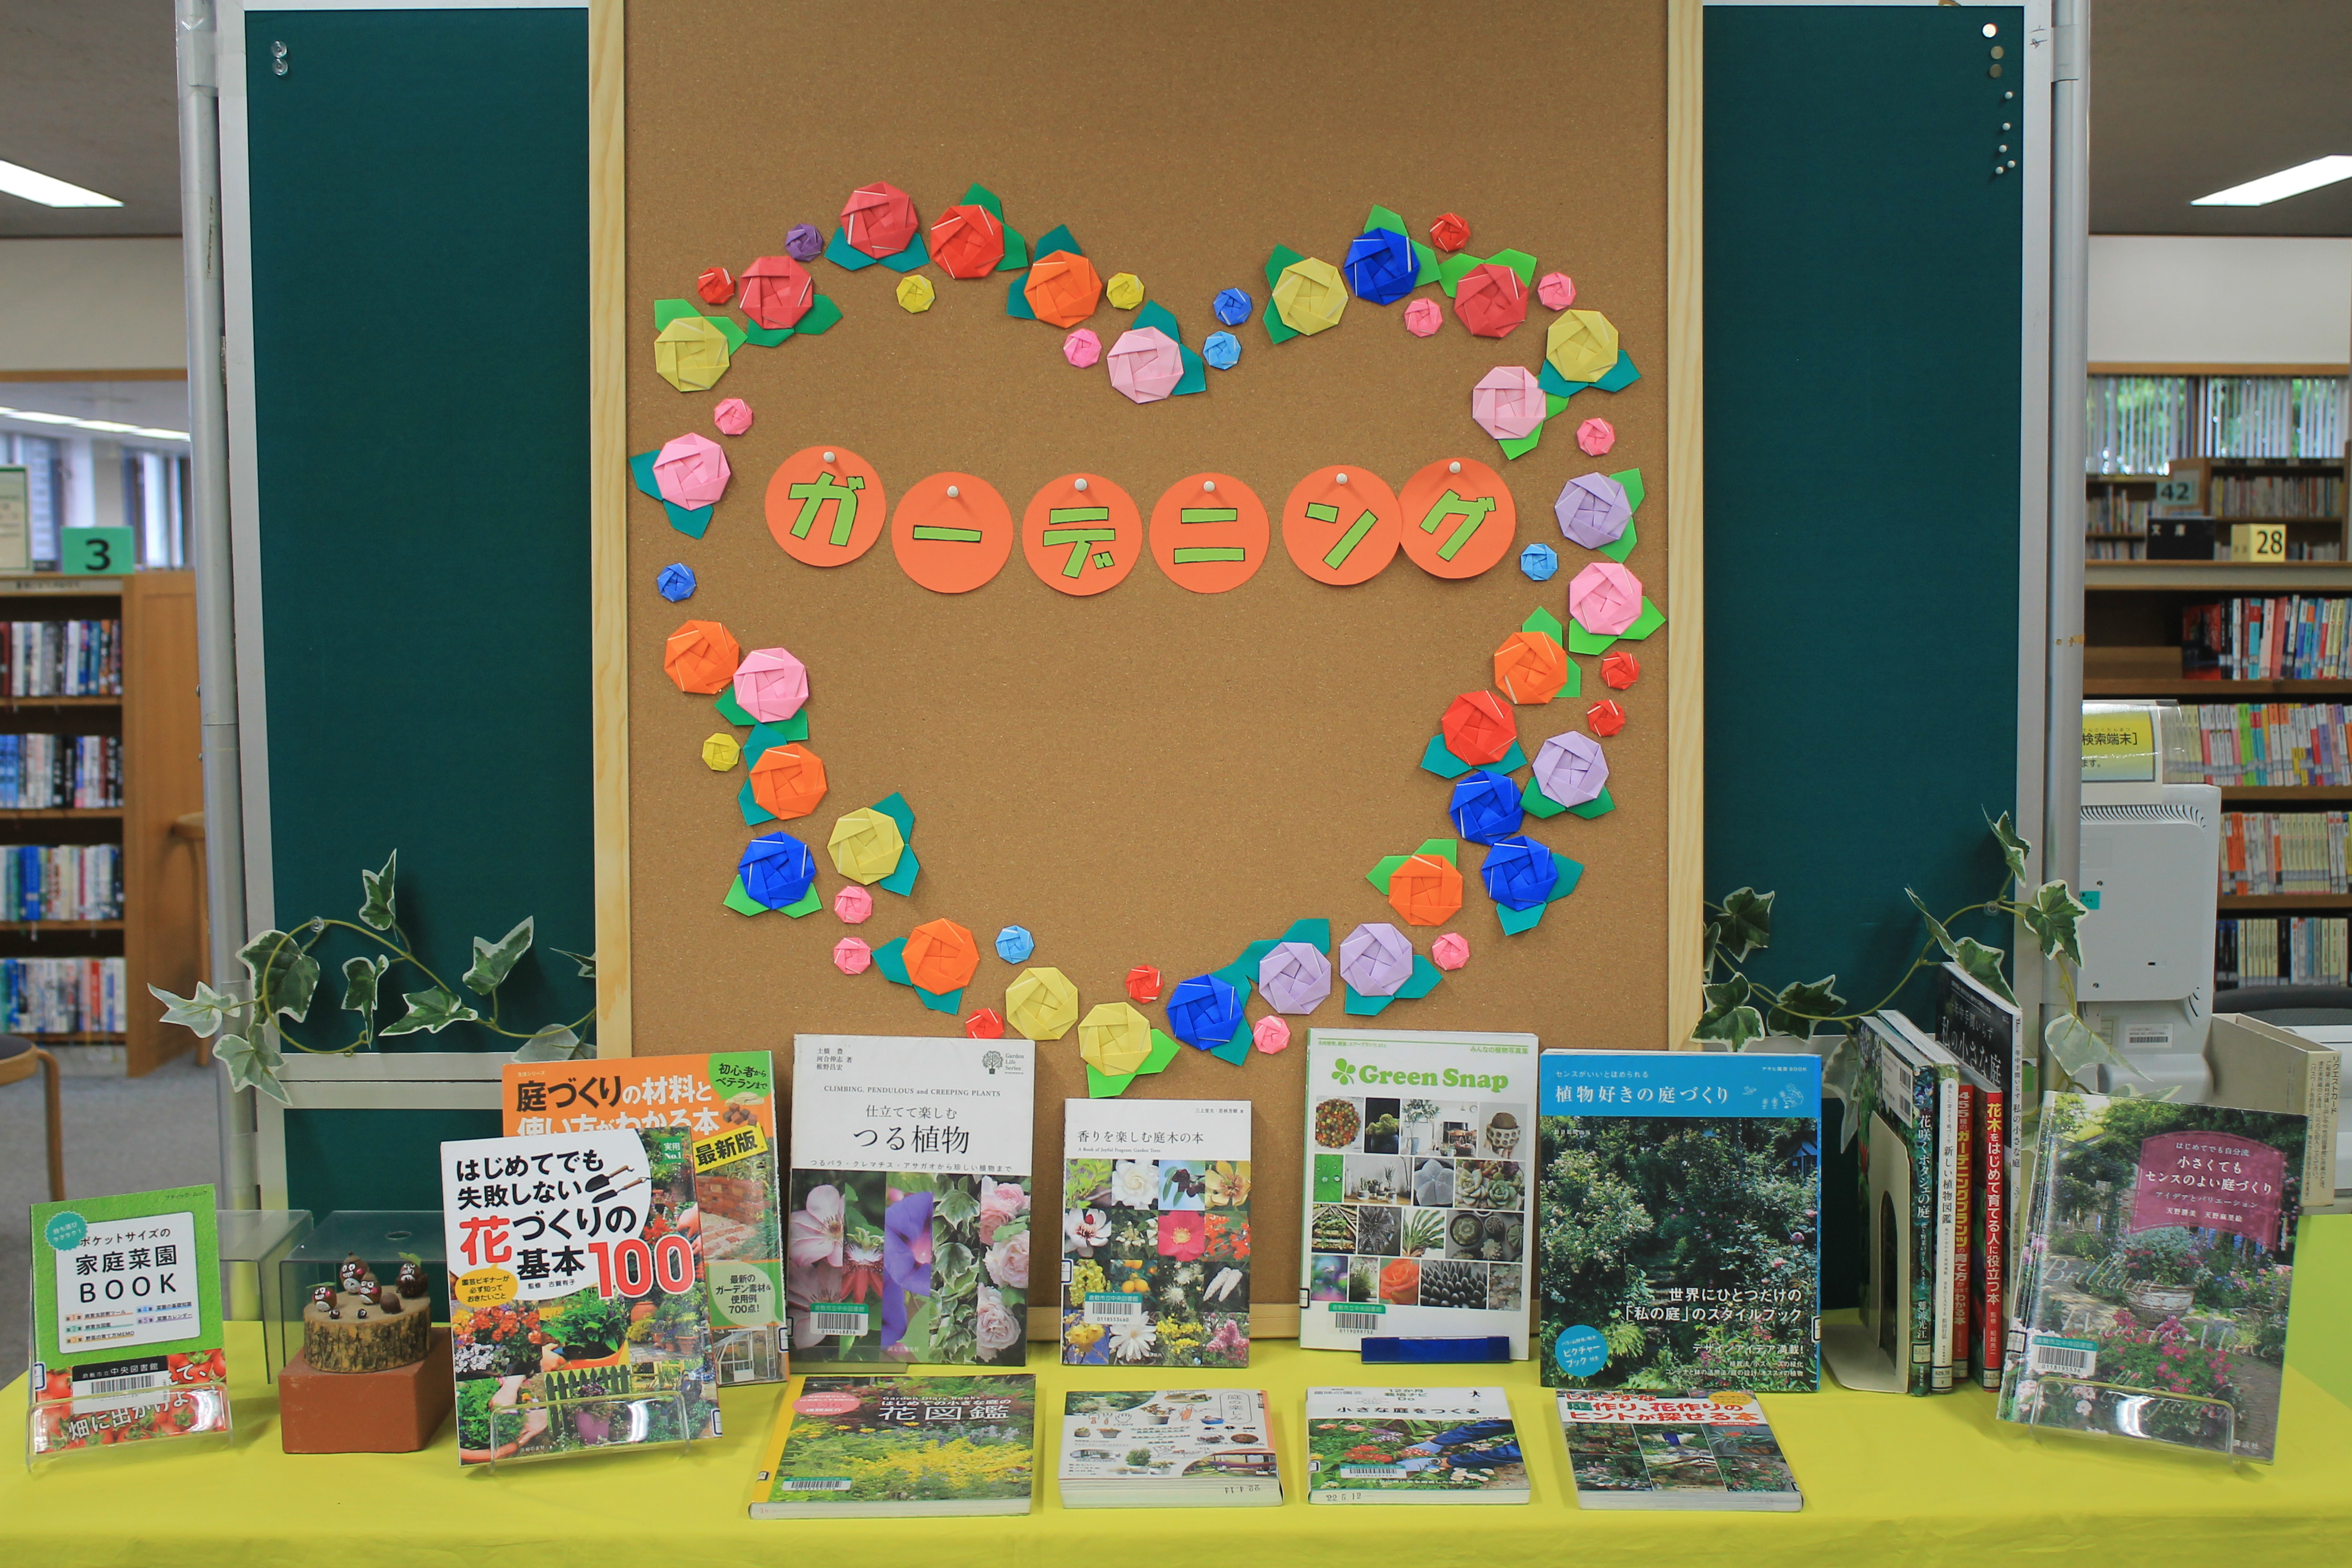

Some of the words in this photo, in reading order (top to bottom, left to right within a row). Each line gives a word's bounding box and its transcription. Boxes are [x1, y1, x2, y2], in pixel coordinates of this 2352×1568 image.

[2161, 484, 2189, 500] 42
[788, 471, 1496, 579] ガーデニング
[2257, 531, 2282, 554] 28
[85, 538, 111, 571] 3
[1470, 1046, 1528, 1054] みんなの植物写真集
[718, 1063, 766, 1079] 初心者から
[1359, 1065, 1438, 1086] Green
[1442, 1068, 1508, 1092] Snap
[1556, 1070, 1648, 1079] センスがいいとほめられる
[716, 1076, 767, 1090] ベテランまで
[2331, 1055, 2339, 1115] リクエストカード
[516, 1074, 712, 1113] 庭づくりの材料と
[1555, 1085, 1729, 1103] 植物好きの庭づくり
[866, 1105, 957, 1119] 仕立てて楽しむ
[517, 1107, 720, 1136] 使い方がわかる本
[853, 1125, 970, 1154] つる植物
[1077, 1130, 1204, 1144] 香りを楽しむ庭木の本
[2012, 1104, 2021, 1168] 私の小さな庭
[663, 1142, 681, 1152] 実用
[695, 1130, 759, 1167] 最新版
[2176, 1142, 2250, 1157] はじめてでも自分流
[456, 1149, 604, 1182] はじめてでも
[810, 1159, 1012, 1173] つるバラ・クレマチス・アサガオから珍しい植物まで
[1917, 1115, 1931, 1218] 花咲くポタジェの庭
[2176, 1156, 2242, 1174] 小さくても
[1941, 1146, 1953, 1224] 新しい植物図鑑
[2145, 1170, 2273, 1196] センスのよい庭づくり
[458, 1179, 582, 1210] 失敗しない
[2155, 1191, 2257, 1209] アイデアとバリエーション
[1986, 1103, 2002, 1305] 花木をはじめて育てる人に役立つ本
[80, 1228, 171, 1246] ポケットサイズの
[459, 1206, 636, 1266] 花づくりの
[76, 1244, 177, 1276] 家庭菜園
[80, 1273, 177, 1303] BOOK
[461, 1275, 510, 1286] 園芸ビギナーが
[730, 1275, 756, 1284] 最新の
[467, 1292, 507, 1302] おきたいこと
[469, 1284, 503, 1294] 必ず知って
[1669, 1287, 1801, 1303] 世界にひとつだけの
[731, 1293, 757, 1304] 使用例
[728, 1303, 760, 1314] 700点!
[1565, 1393, 1657, 1402] じょうずな
[1567, 1401, 1743, 1411] 庭作り、花作りの
[878, 1405, 1009, 1420] 花図鑑
[1227, 1394, 1243, 1420] 庭の楽しみ
[1571, 1412, 1759, 1422] ヒントが探せる本
